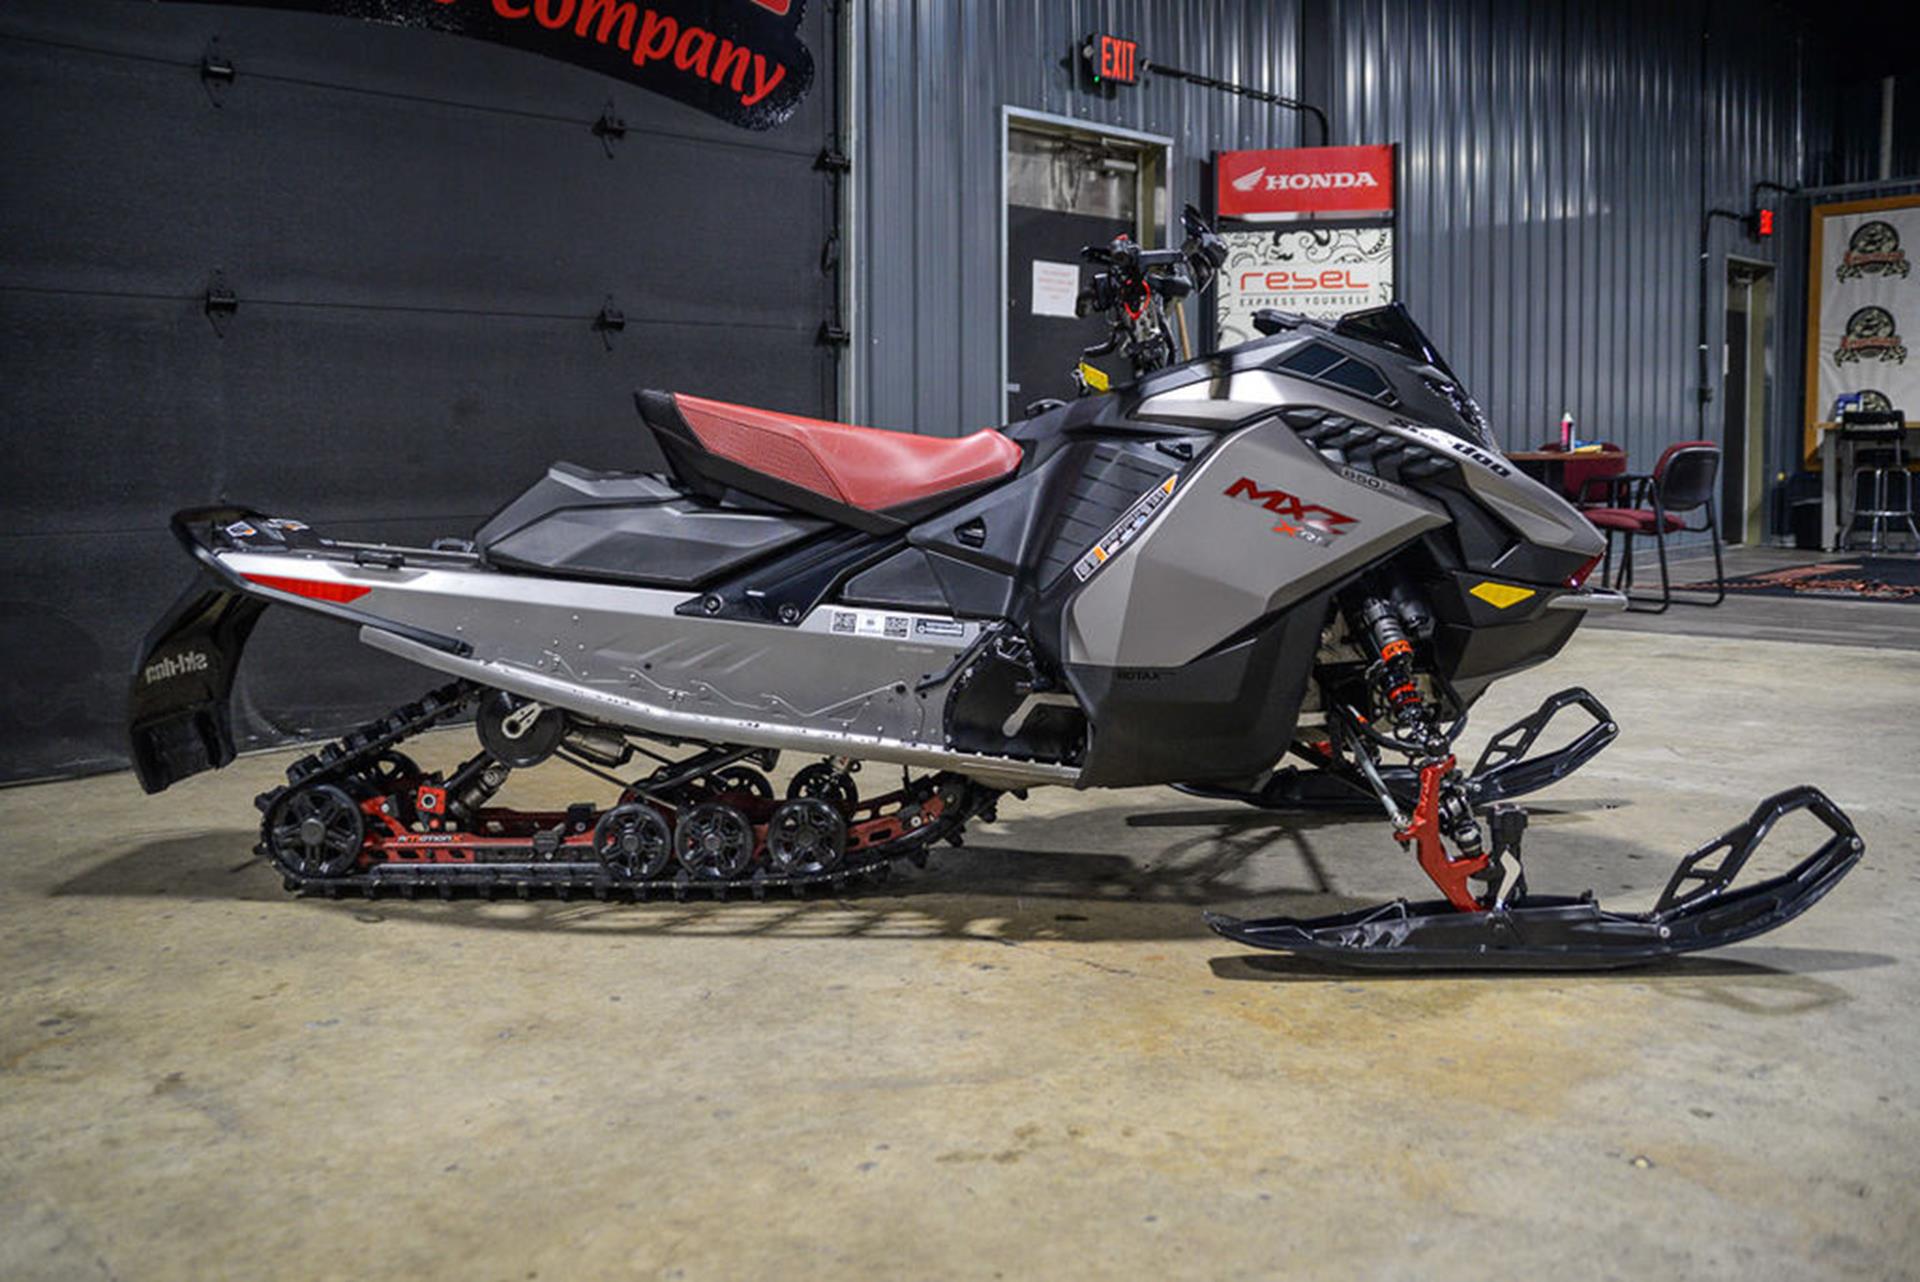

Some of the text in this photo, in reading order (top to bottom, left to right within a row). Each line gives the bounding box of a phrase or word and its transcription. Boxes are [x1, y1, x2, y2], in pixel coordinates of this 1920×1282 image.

[1102, 36, 1136, 81] EXIT
[1265, 171, 1379, 191] HONDA
[1240, 295, 1369, 307] EXPRESS YOURSELF
[1223, 476, 1361, 535] MXZ
